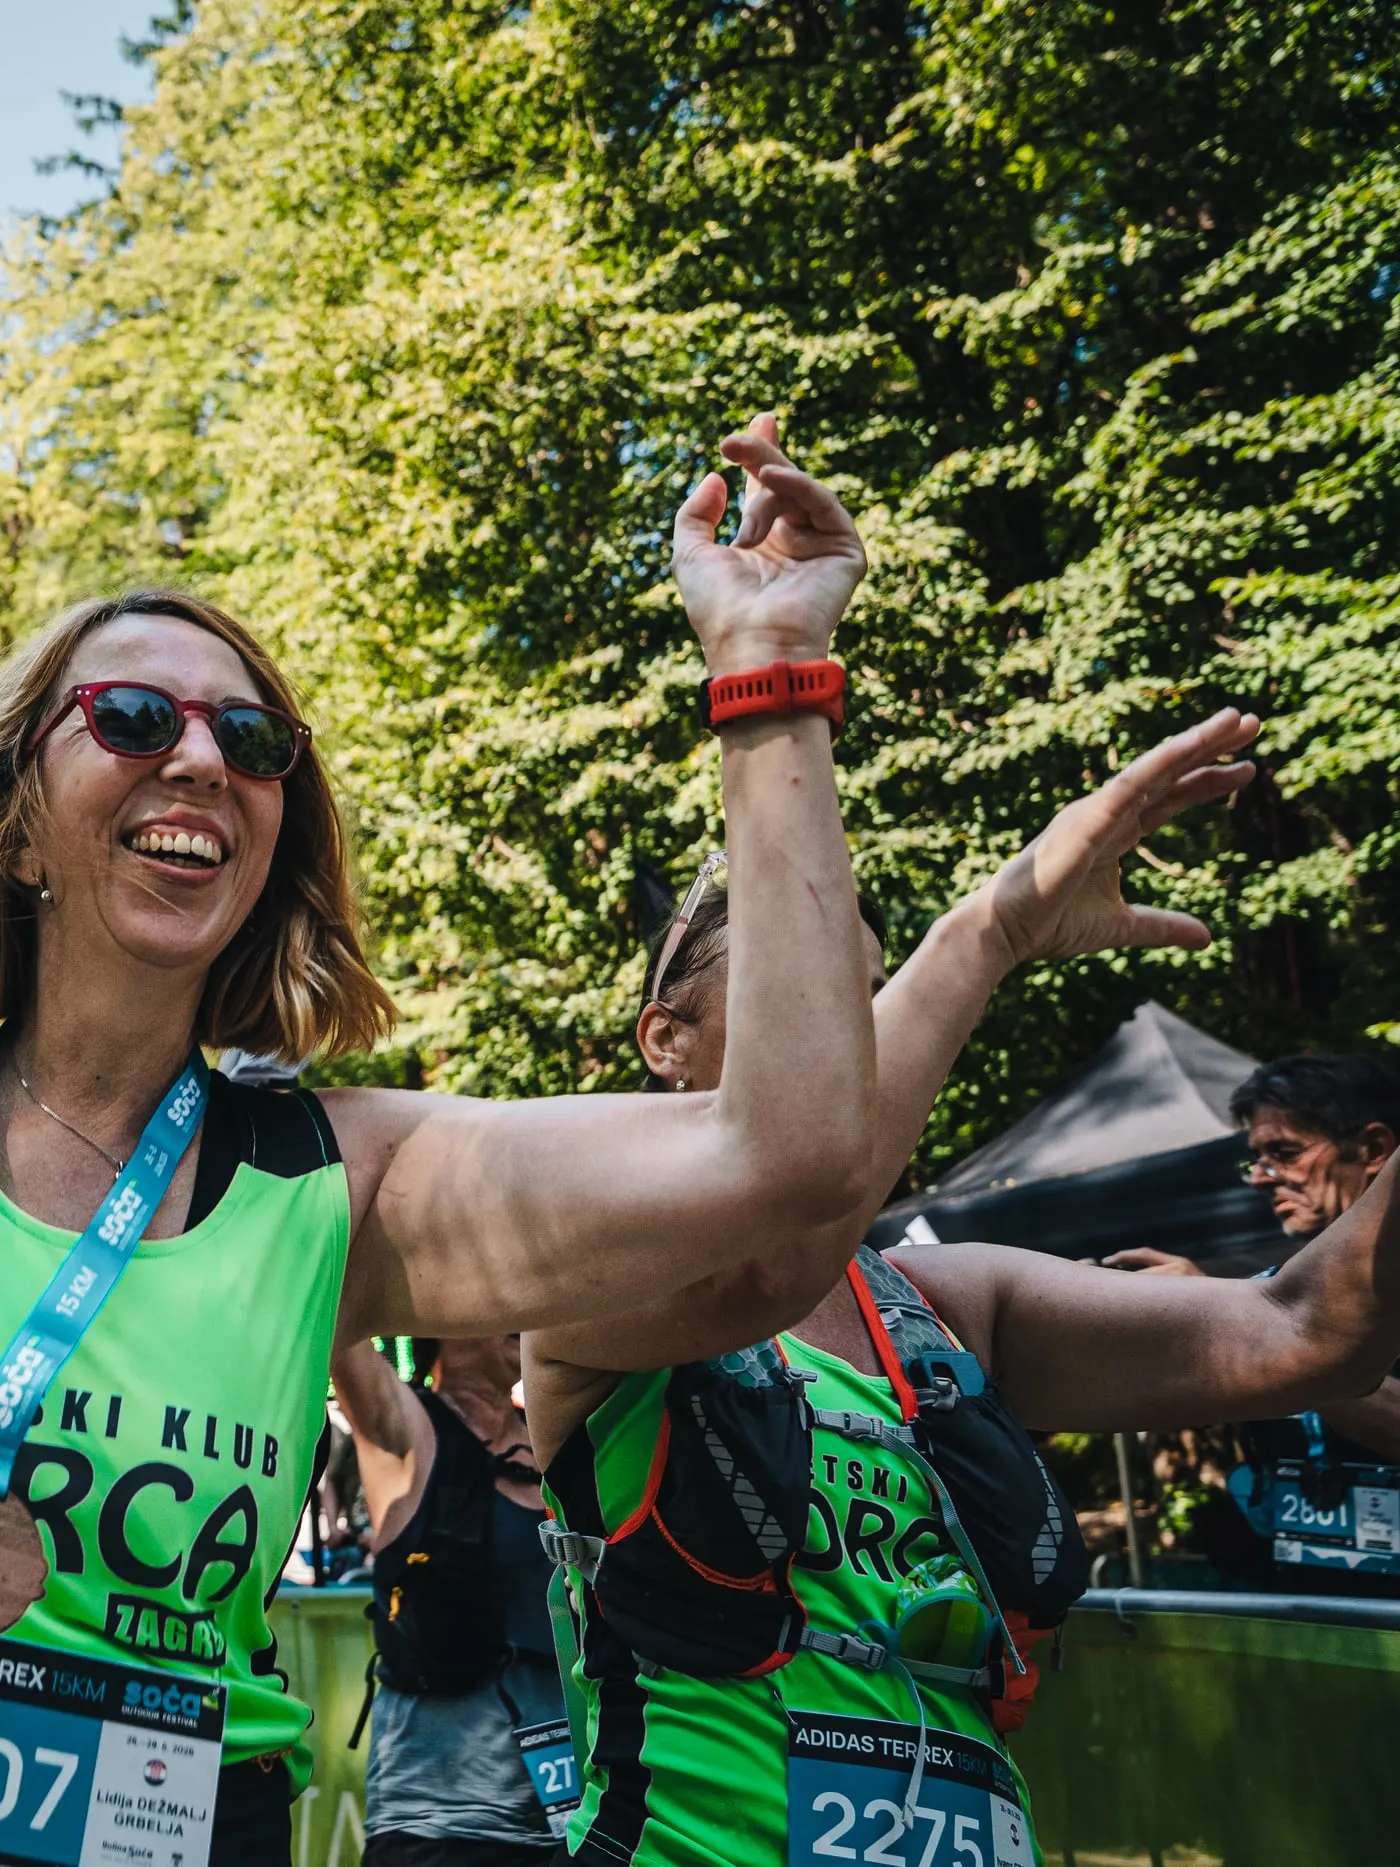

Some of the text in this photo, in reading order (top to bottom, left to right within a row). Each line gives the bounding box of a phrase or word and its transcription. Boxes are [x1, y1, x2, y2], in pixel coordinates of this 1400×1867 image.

[55, 1289, 79, 1319] 15
[162, 1405, 280, 1478] KLUB
[810, 1453, 908, 1503] TSKI
[114, 1604, 224, 1660] ZAGR
[50, 1668, 107, 1704] 15KM
[795, 1727, 875, 1754] ADIDAS
[878, 1735, 954, 1768] TERREX
[538, 1755, 575, 1794] 27
[96, 1788, 207, 1822] Lidija DEŽMALJ
[811, 1790, 984, 1867] 2275
